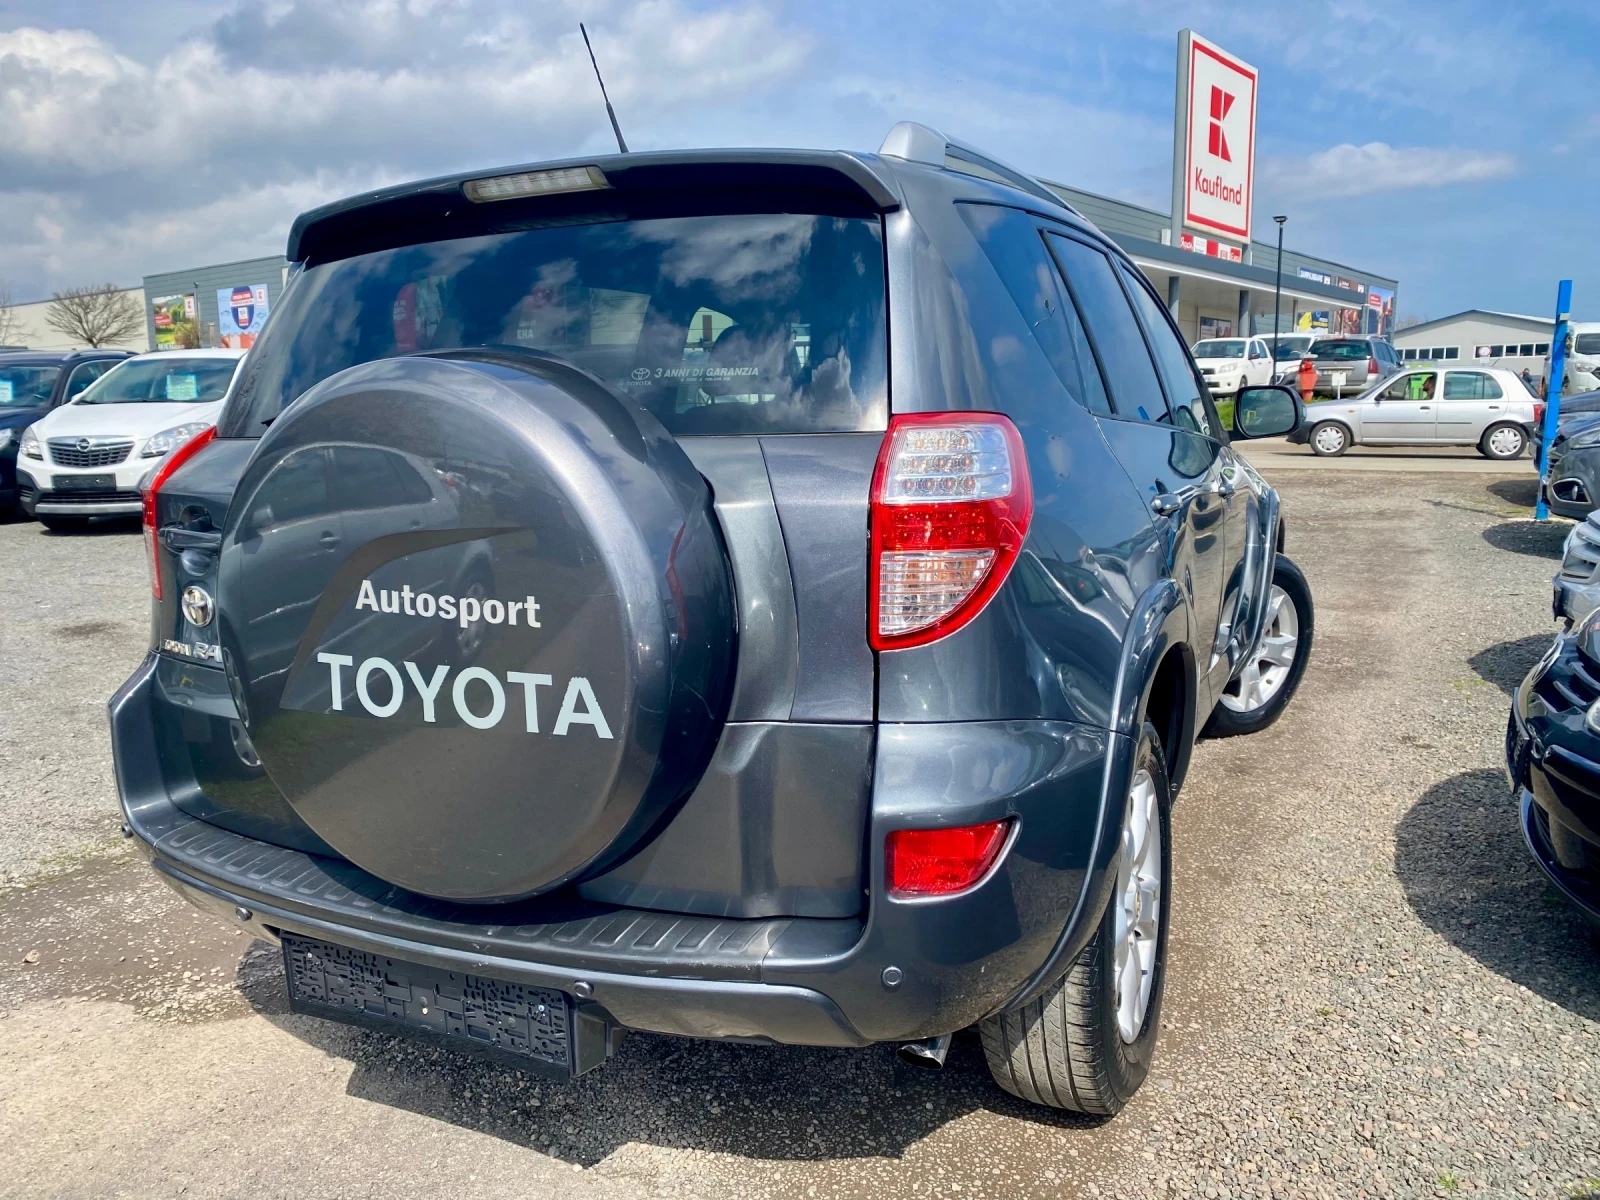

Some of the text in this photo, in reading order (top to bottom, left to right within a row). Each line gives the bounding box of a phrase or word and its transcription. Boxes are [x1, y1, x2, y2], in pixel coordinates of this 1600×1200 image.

[1208, 84, 1236, 163] K
[1194, 166, 1243, 206] Kaufland
[654, 367, 759, 378] 3 ANNI DI GARANZIA
[355, 579, 542, 629] Autosport
[316, 652, 614, 740] TOYOTA
